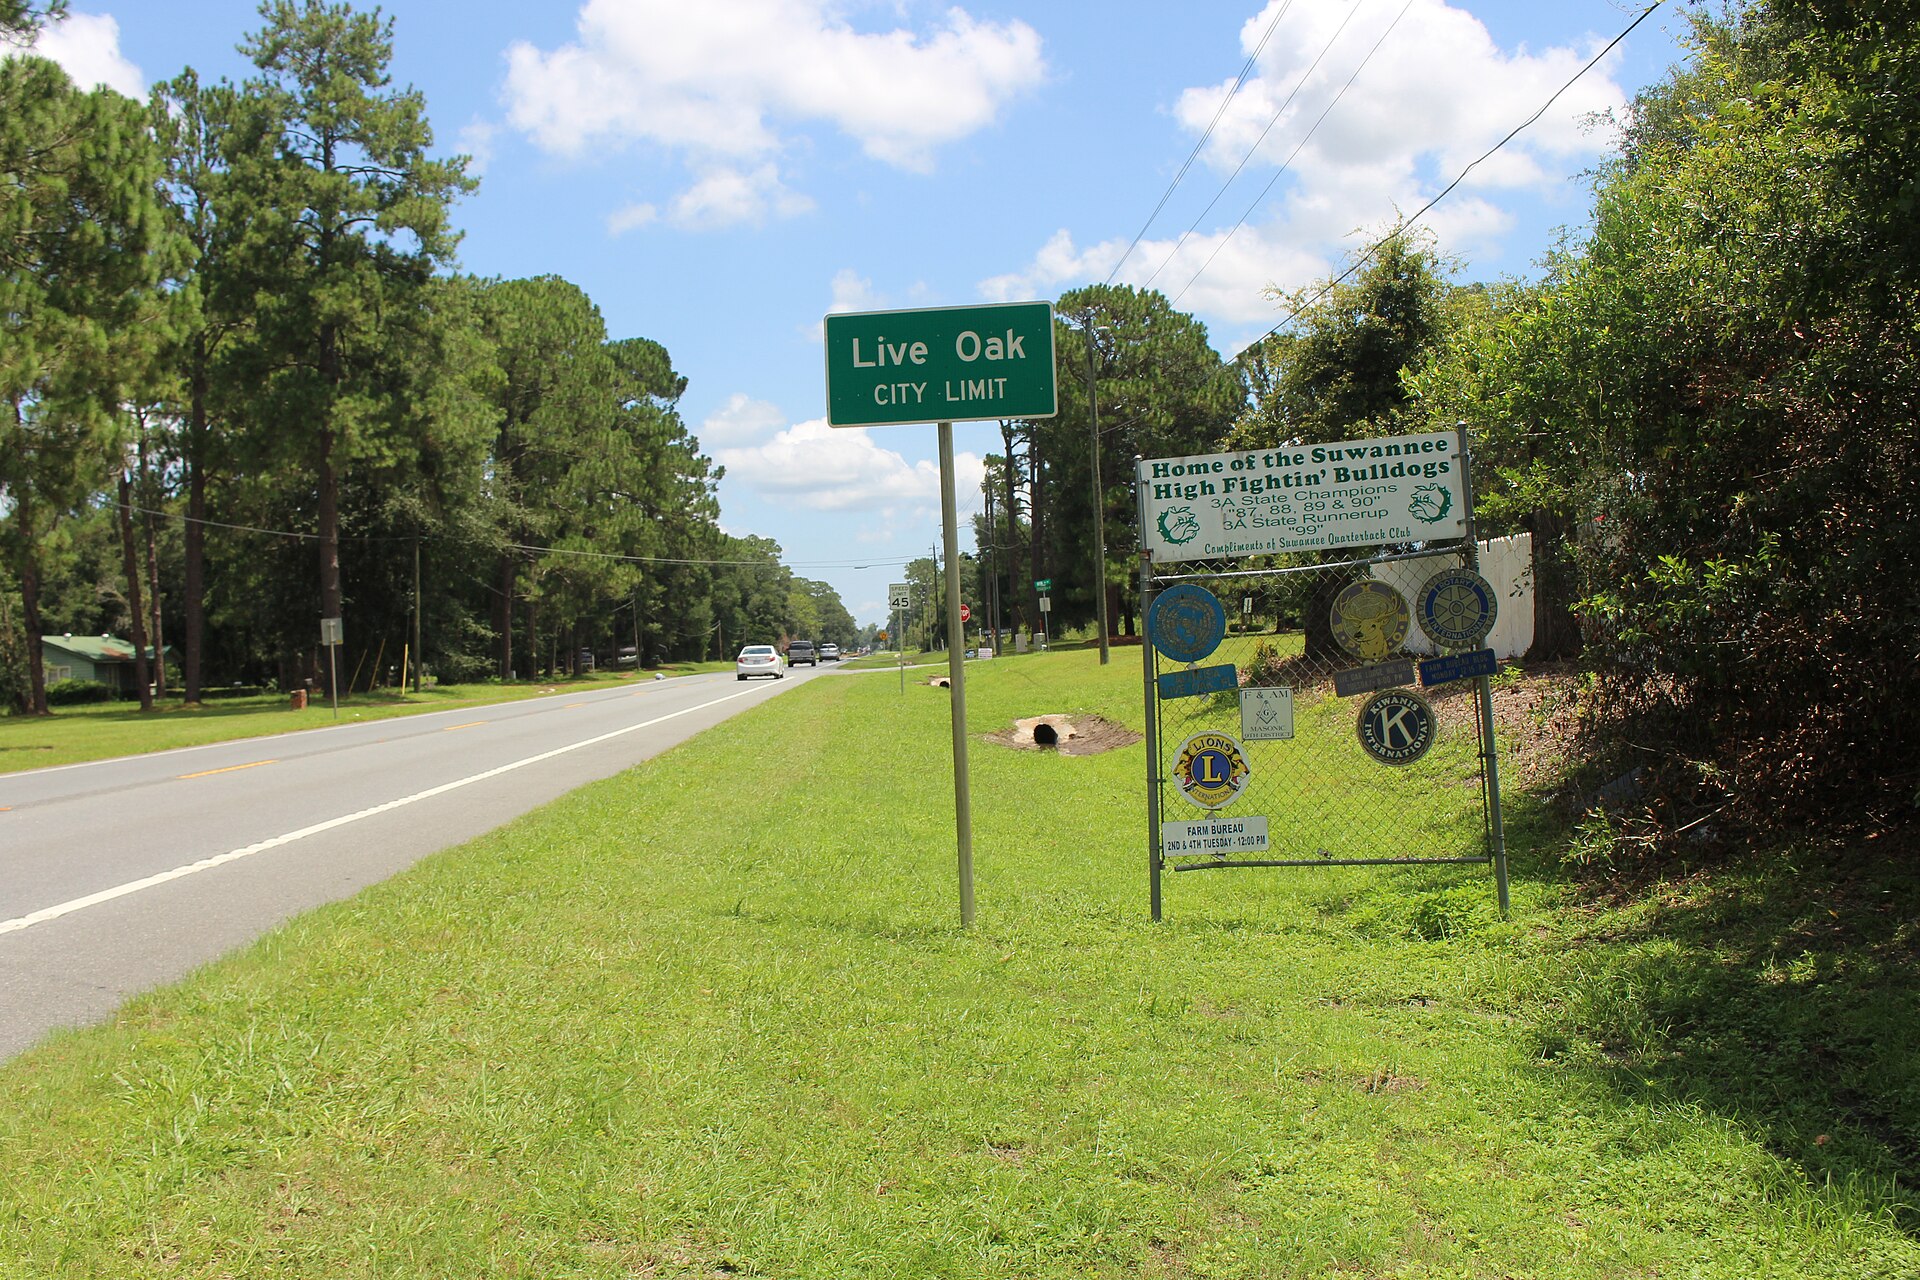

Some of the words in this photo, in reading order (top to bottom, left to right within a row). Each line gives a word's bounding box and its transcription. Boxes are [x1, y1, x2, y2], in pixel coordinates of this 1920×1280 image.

[852, 336, 929, 368] Live
[955, 328, 1026, 362] Oak
[874, 382, 928, 406] CITY
[945, 377, 1008, 402] LIMIT
[1151, 460, 1224, 479] Home
[1230, 454, 1256, 472] of
[1262, 451, 1305, 468] the
[1311, 439, 1448, 464] Suwannee
[1153, 479, 1216, 501] High
[1221, 468, 1327, 495] Fightin'
[1333, 460, 1450, 484] Bulldogs
[1210, 497, 1236, 509] 3A
[1241, 493, 1288, 506] State
[1294, 484, 1398, 501] Champions
[1228, 507, 1263, 518] "87,
[1269, 503, 1297, 515] 88,
[1303, 500, 1326, 512] 89
[1332, 499, 1345, 510] &
[1351, 495, 1381, 508] 90"
[1223, 519, 1248, 531] 3A
[1252, 516, 1297, 529] State
[1302, 508, 1389, 524] Runnerup
[1288, 523, 1324, 536] "99"
[1204, 538, 1264, 556] Compliments
[1266, 537, 1276, 551] of
[1279, 535, 1325, 549] Suwannee
[1328, 528, 1386, 546] Quarterback
[1388, 526, 1411, 539] Club
[1439, 579, 1471, 588] ROTARY
[891, 597, 909, 607] 45
[1430, 617, 1486, 640] INTERNATIONAL
[1256, 691, 1264, 699] &
[1269, 690, 1288, 698] AM
[1370, 696, 1419, 715] KIWANIS
[1364, 718, 1428, 758] INTERNATIONAL
[1380, 705, 1414, 749] K
[1192, 737, 1231, 752] LIONS
[1201, 755, 1222, 782] L
[1187, 825, 1209, 836] FARM
[1211, 823, 1244, 835] BUREAU
[1167, 840, 1181, 851] 2ND
[1182, 840, 1187, 850] &
[1188, 839, 1202, 849] 4TH
[1203, 837, 1232, 849] TUESDAY
[1237, 836, 1255, 846] 12:00
[1256, 835, 1266, 845] PM
